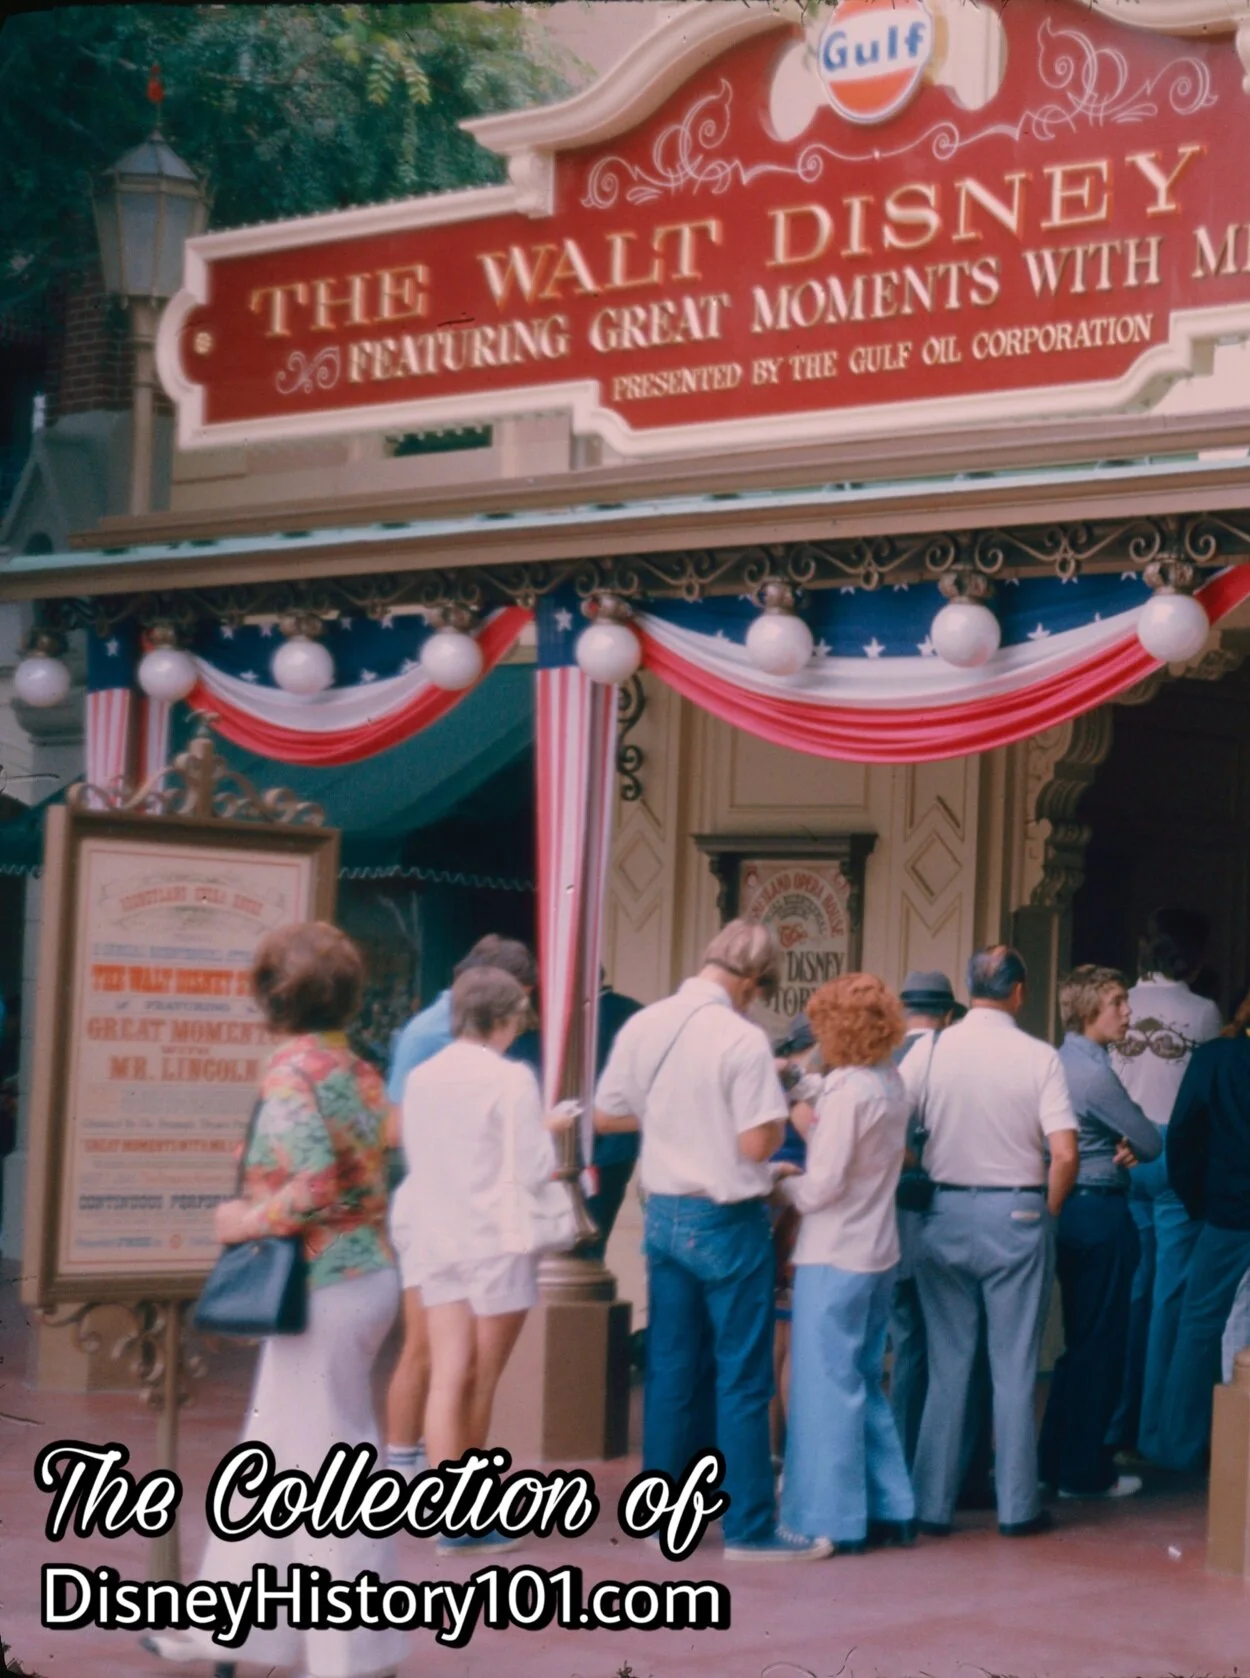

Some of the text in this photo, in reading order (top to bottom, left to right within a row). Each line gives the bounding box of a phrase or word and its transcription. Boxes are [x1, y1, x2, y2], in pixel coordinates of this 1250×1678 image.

[820, 21, 928, 73] Gulf
[250, 264, 430, 338] THE
[477, 217, 723, 307] WALT
[765, 142, 1208, 268] DISNEY
[348, 314, 570, 385] FEATURING
[589, 293, 729, 354] GREAT
[751, 256, 1000, 336] MOMENTS
[1022, 235, 1164, 296] WITH
[612, 313, 1155, 402] PRESENTED BY THE GULF OIL CORPORATION
[793, 872, 825, 899] OPERA
[821, 892, 844, 938] HOUSE
[786, 950, 847, 983] DISNEY
[87, 1017, 165, 1042] GREAT
[161, 1057, 259, 1082] LINCOLN
